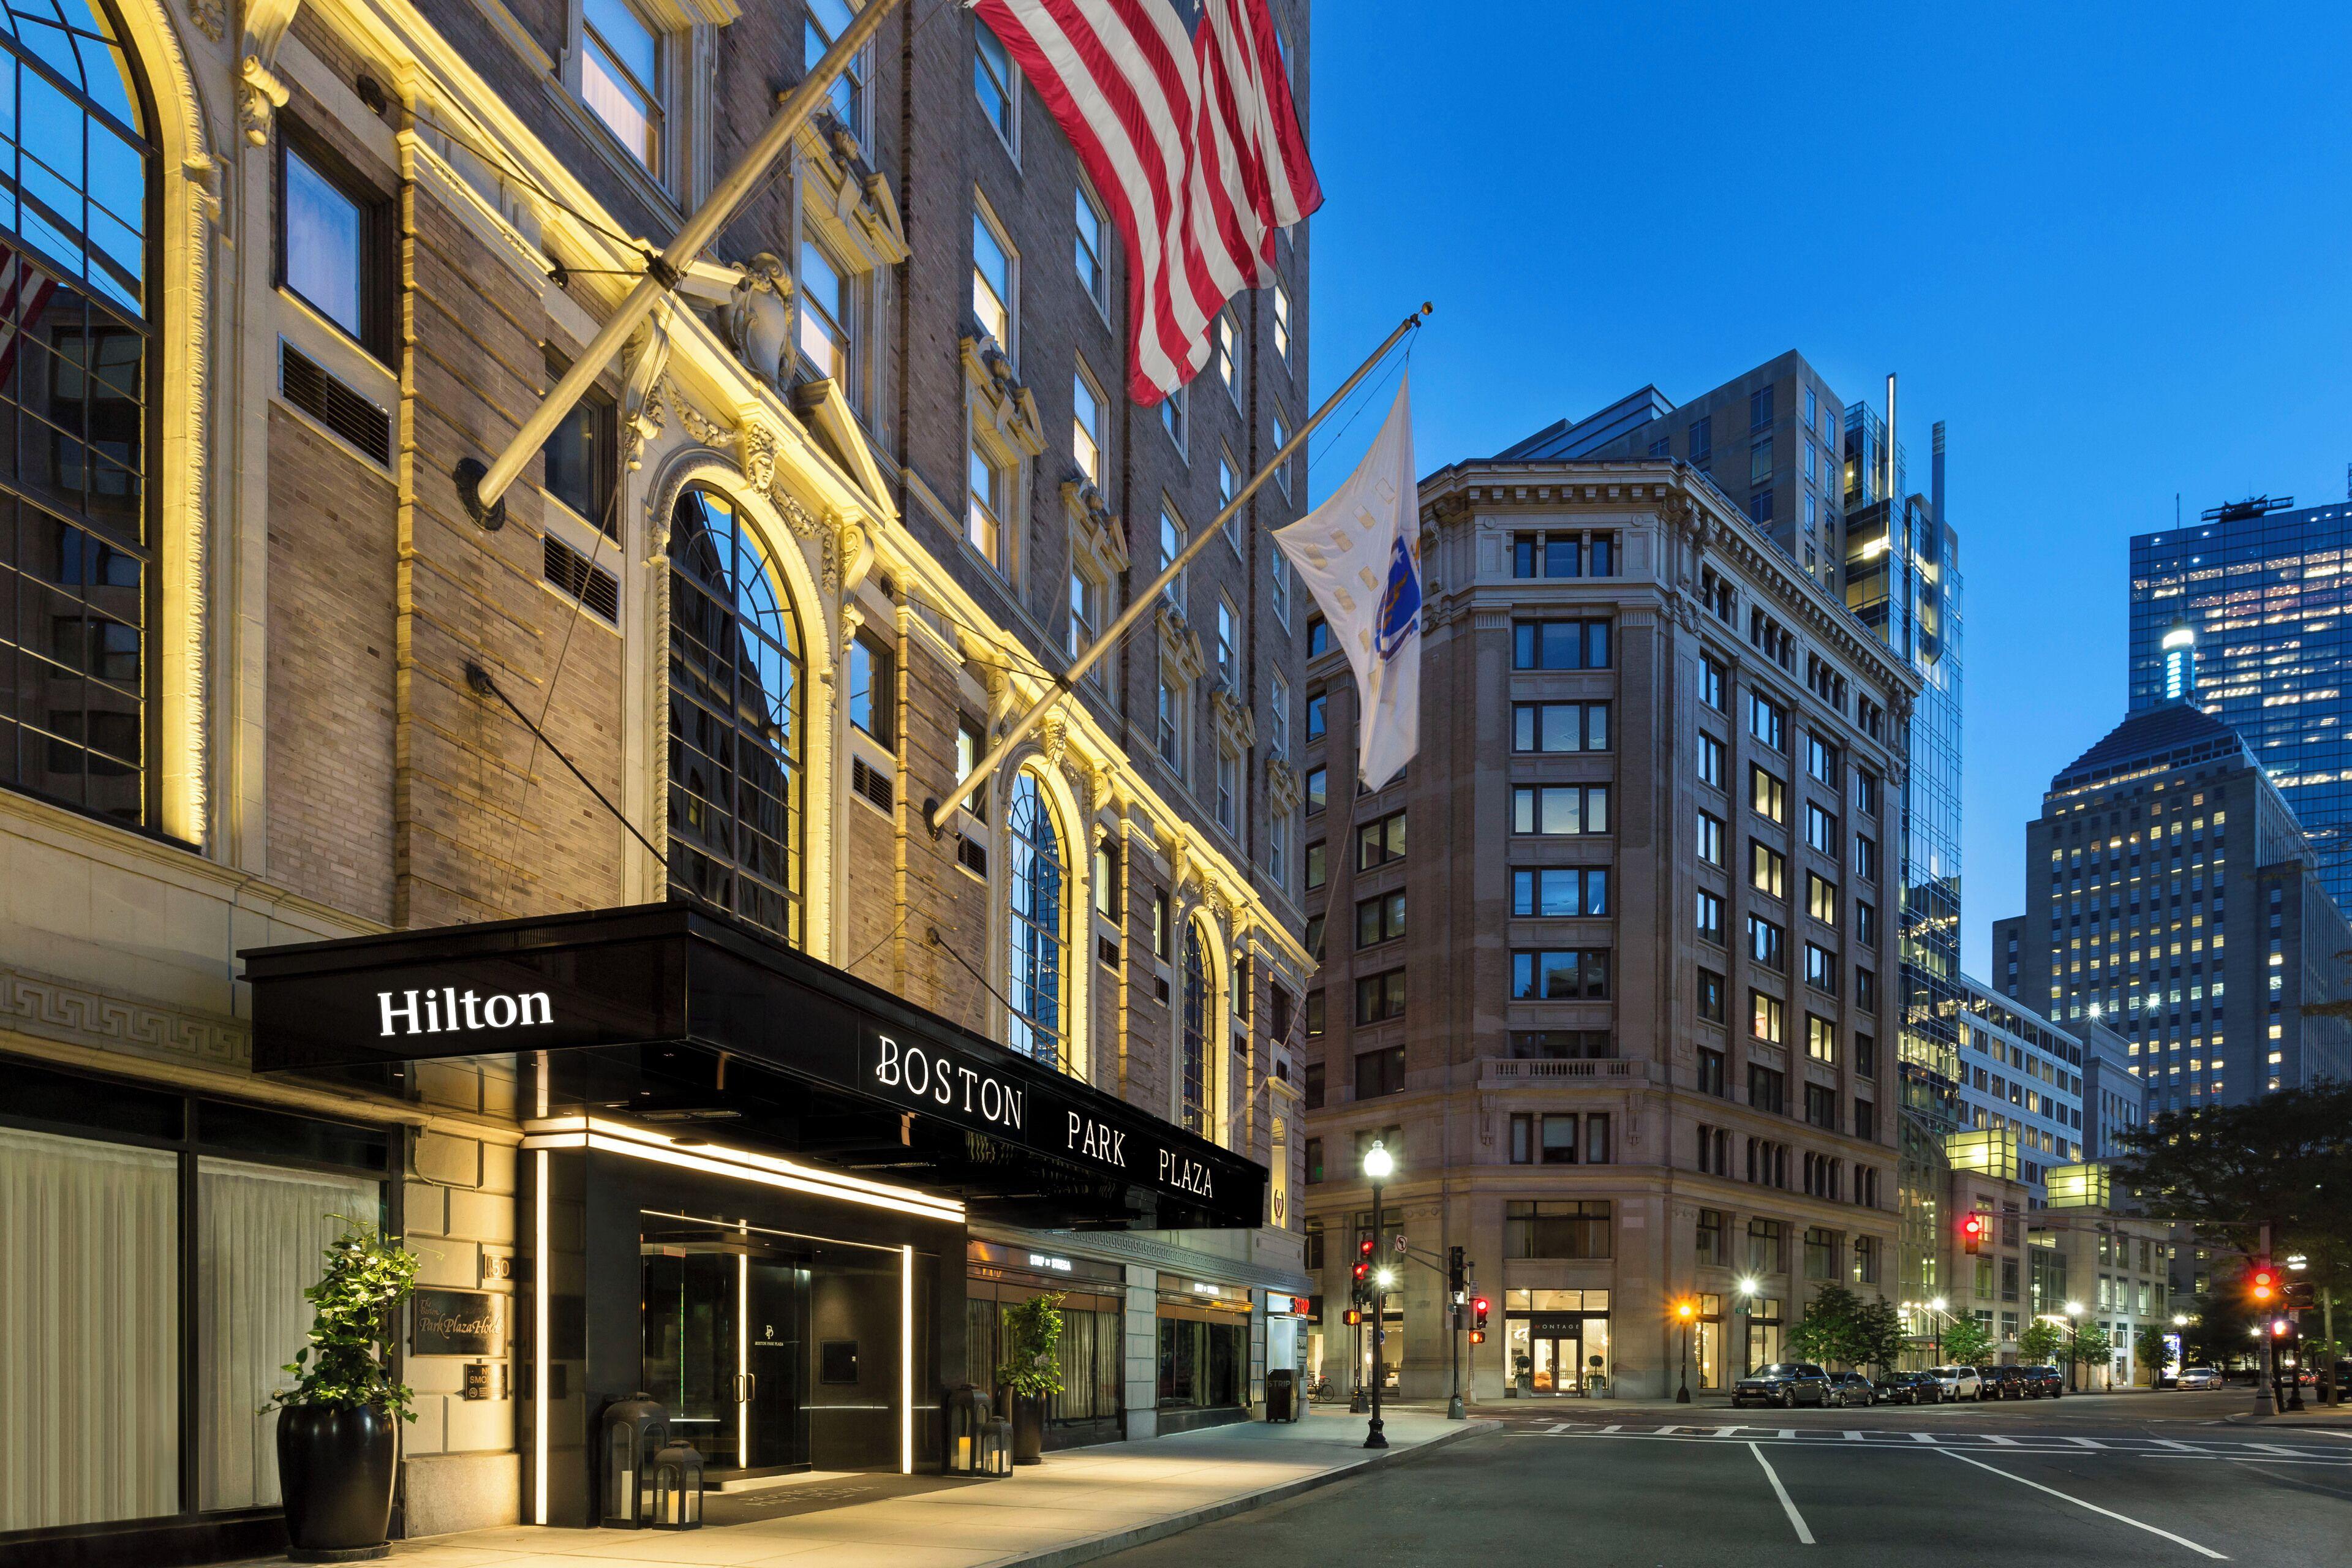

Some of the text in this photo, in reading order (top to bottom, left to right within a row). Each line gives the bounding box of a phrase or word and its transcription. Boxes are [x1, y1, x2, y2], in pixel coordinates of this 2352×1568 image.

[377, 987, 554, 1036] Hilton
[876, 1035, 1213, 1199] BOSTON PARK PLAZA
[490, 1259, 510, 1277] 50
[419, 1297, 431, 1308] The
[1294, 1298, 1310, 1315] STRIP
[419, 1313, 450, 1339] Park
[443, 1314, 472, 1333] Plaza
